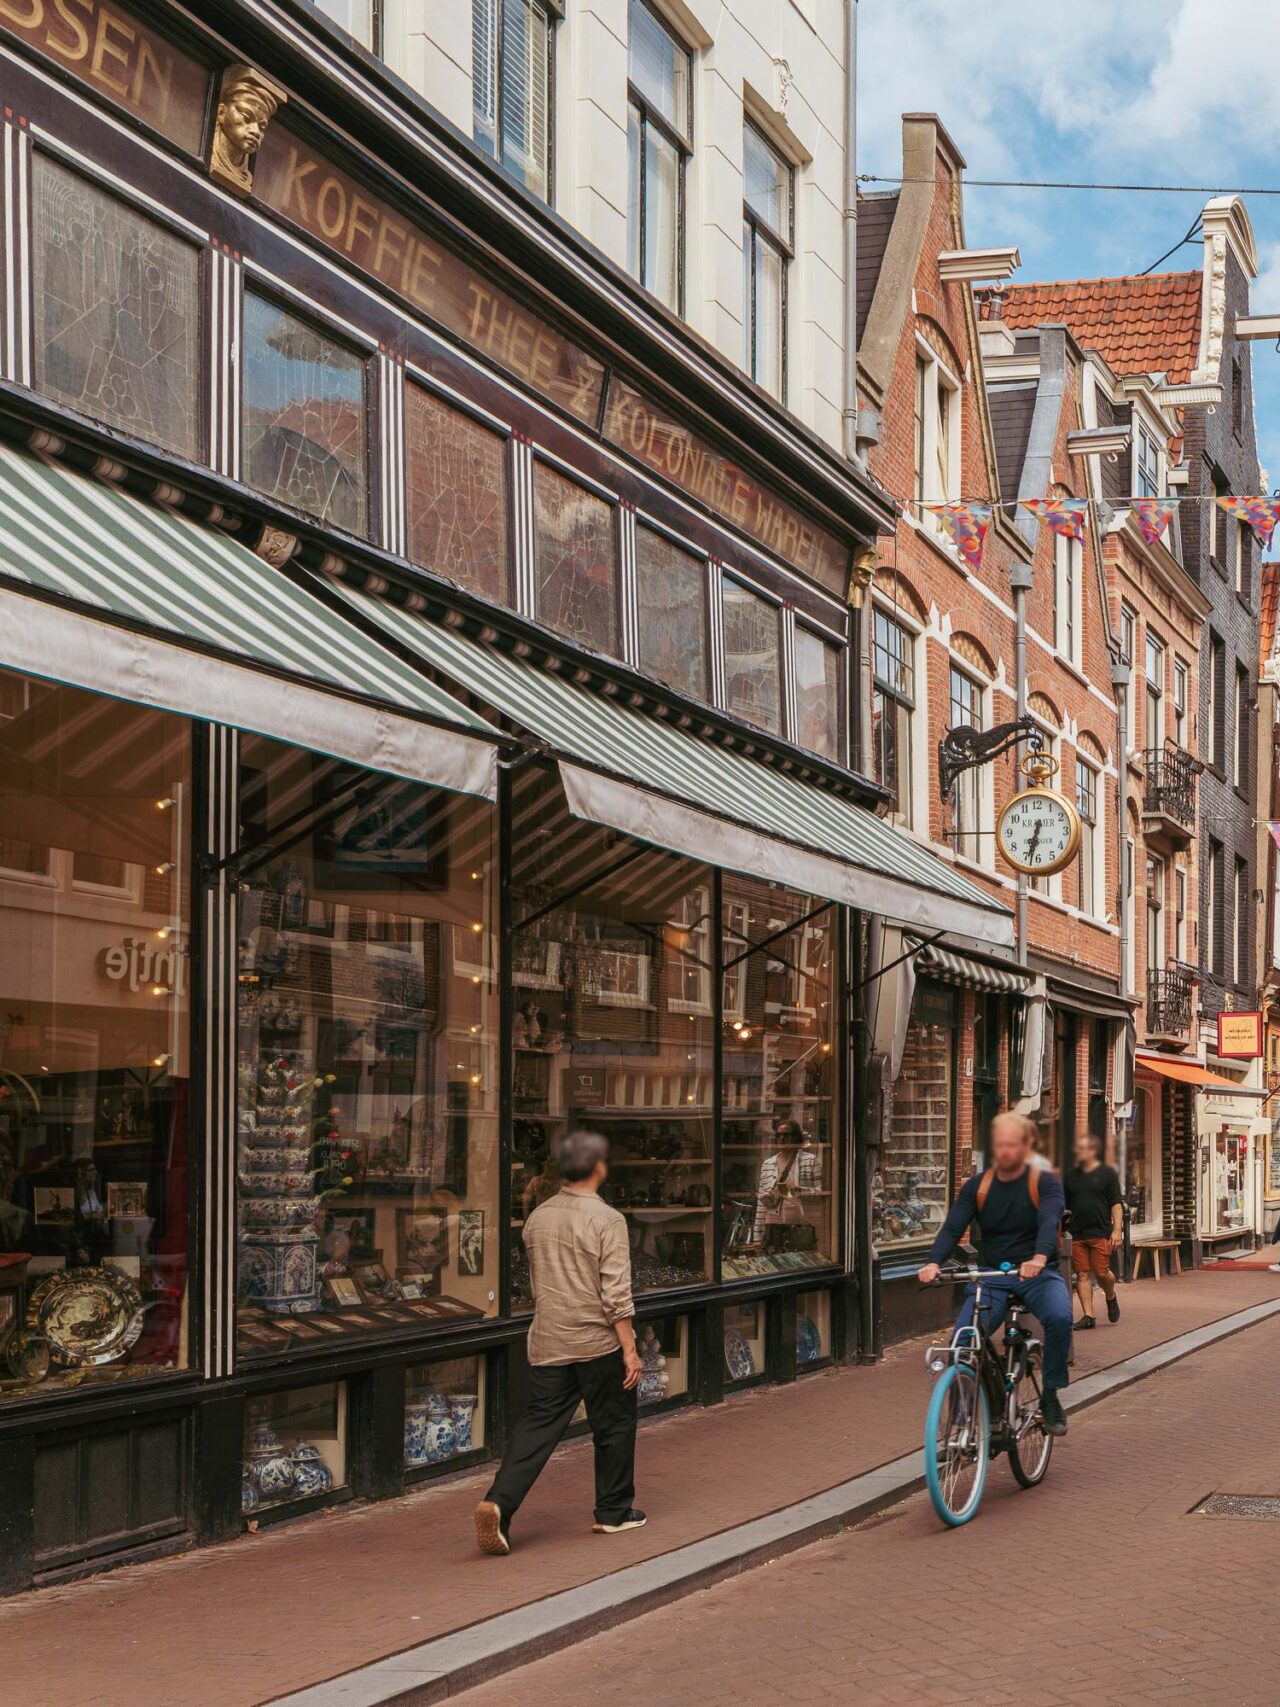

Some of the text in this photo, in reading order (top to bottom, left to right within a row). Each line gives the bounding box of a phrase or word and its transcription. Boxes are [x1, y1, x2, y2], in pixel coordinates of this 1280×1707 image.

[282, 147, 442, 309] KOFFIE
[469, 283, 559, 390] THEE
[609, 393, 750, 525] KOLONIALE
[754, 492, 831, 580] WAREN
[1021, 804, 1029, 813] 11
[1032, 800, 1042, 810] 12
[1048, 803, 1052, 812] 1
[1011, 814, 1020, 824] 10
[1058, 813, 1064, 822] 2
[1006, 828, 1013, 837] 9
[1062, 826, 1069, 836] 3
[1011, 842, 1017, 851] 8
[1058, 841, 1063, 850] 4
[1035, 854, 1041, 863] 6
[1049, 851, 1055, 860] 5
